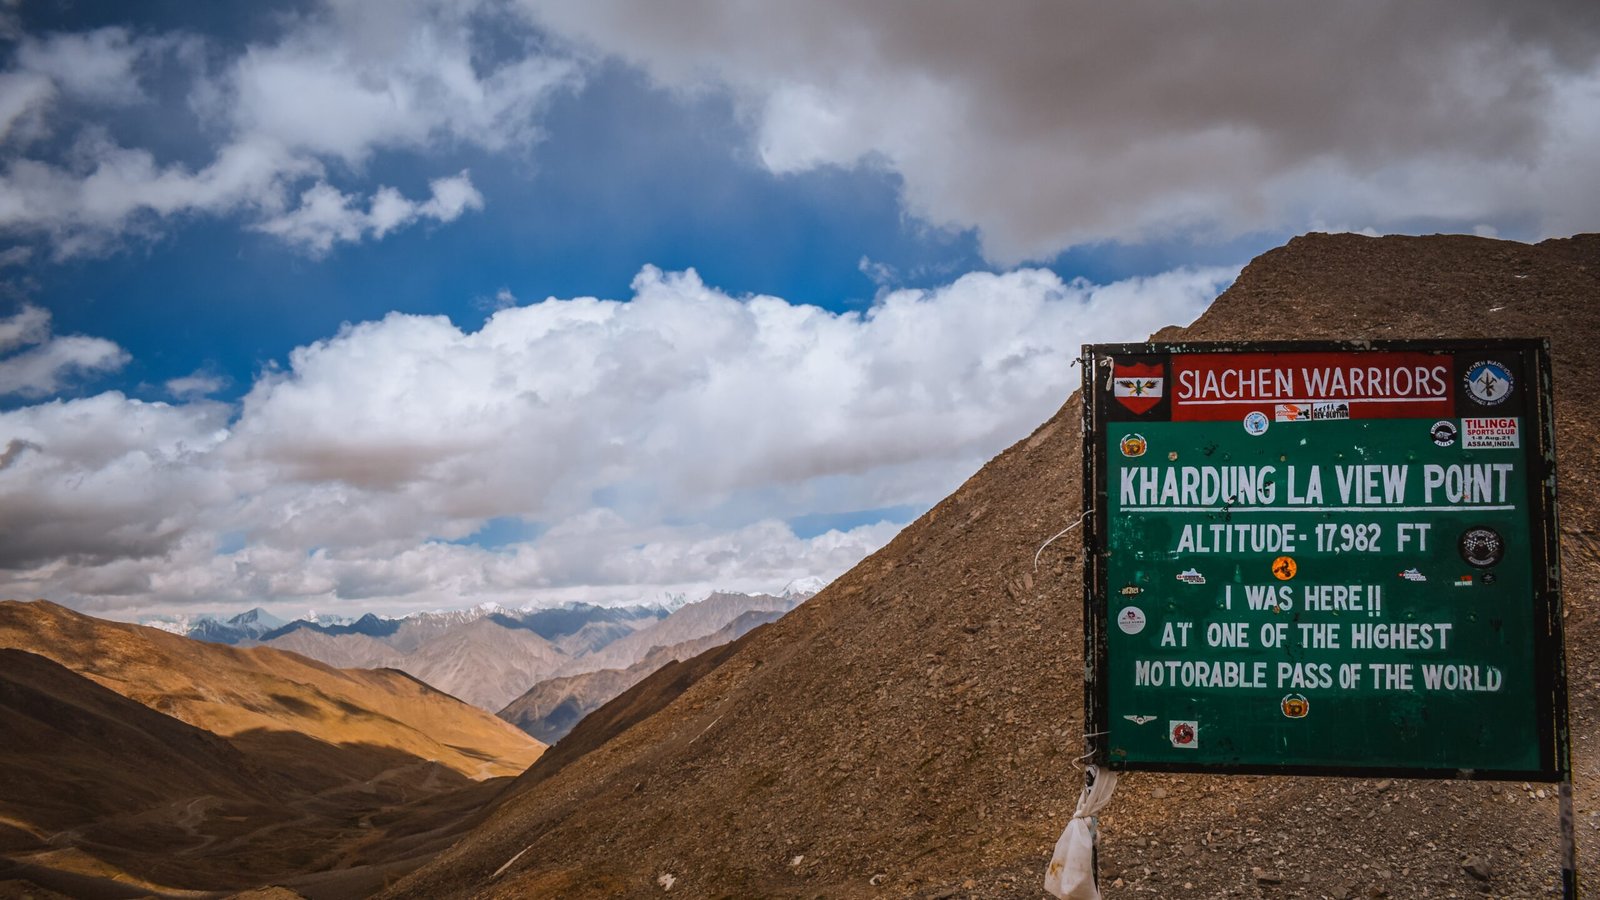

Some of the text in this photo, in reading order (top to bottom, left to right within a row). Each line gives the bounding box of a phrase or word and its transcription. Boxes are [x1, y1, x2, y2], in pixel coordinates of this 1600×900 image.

[1178, 366, 1447, 400] SIACHEN WARRIORS
[1464, 361, 1485, 382] SIACHEN
[1465, 419, 1517, 429] TILINGA
[1120, 464, 1513, 505] KHARDUNG LA VIEW POINT
[1316, 523, 1381, 554] 17,982
[1397, 523, 1431, 551] FT
[1225, 586, 1381, 617] I WAS HERE!!
[1161, 623, 1452, 650] AT ONE OF THE HIGHEST
[1135, 661, 1502, 692] MOTORABLE PASS OF THE WORLD
